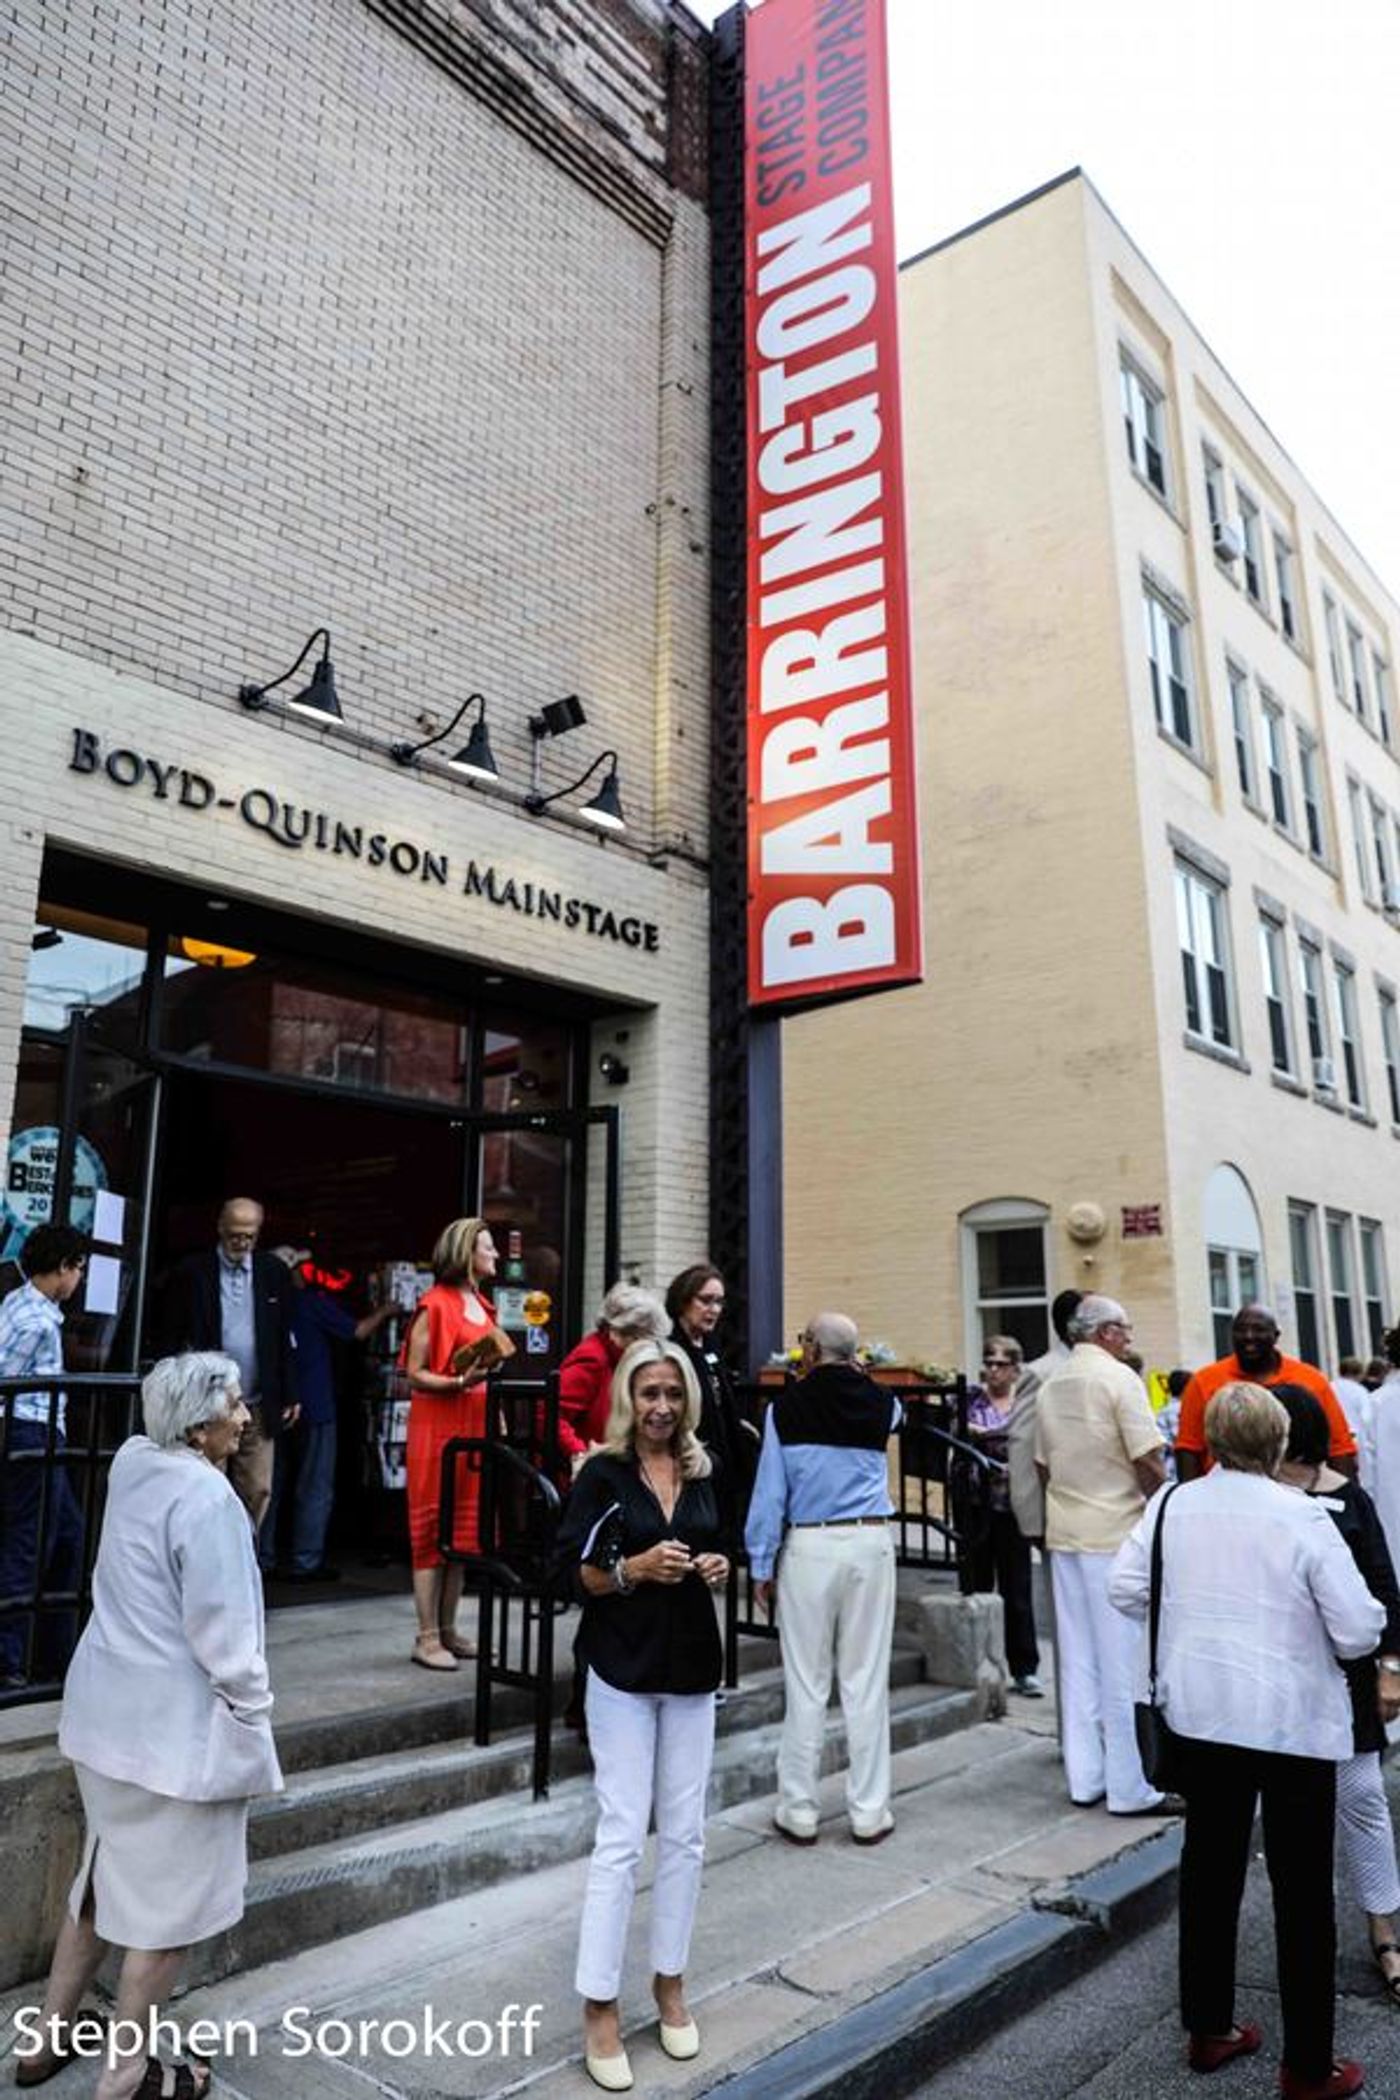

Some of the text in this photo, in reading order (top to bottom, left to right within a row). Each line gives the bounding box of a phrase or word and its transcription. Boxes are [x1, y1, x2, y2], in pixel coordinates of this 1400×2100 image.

[757, 62, 806, 207] STAGE
[757, 181, 896, 987] BARRINGTON
[68, 728, 660, 953] BOYD-QUINSON MAINSTAGE
